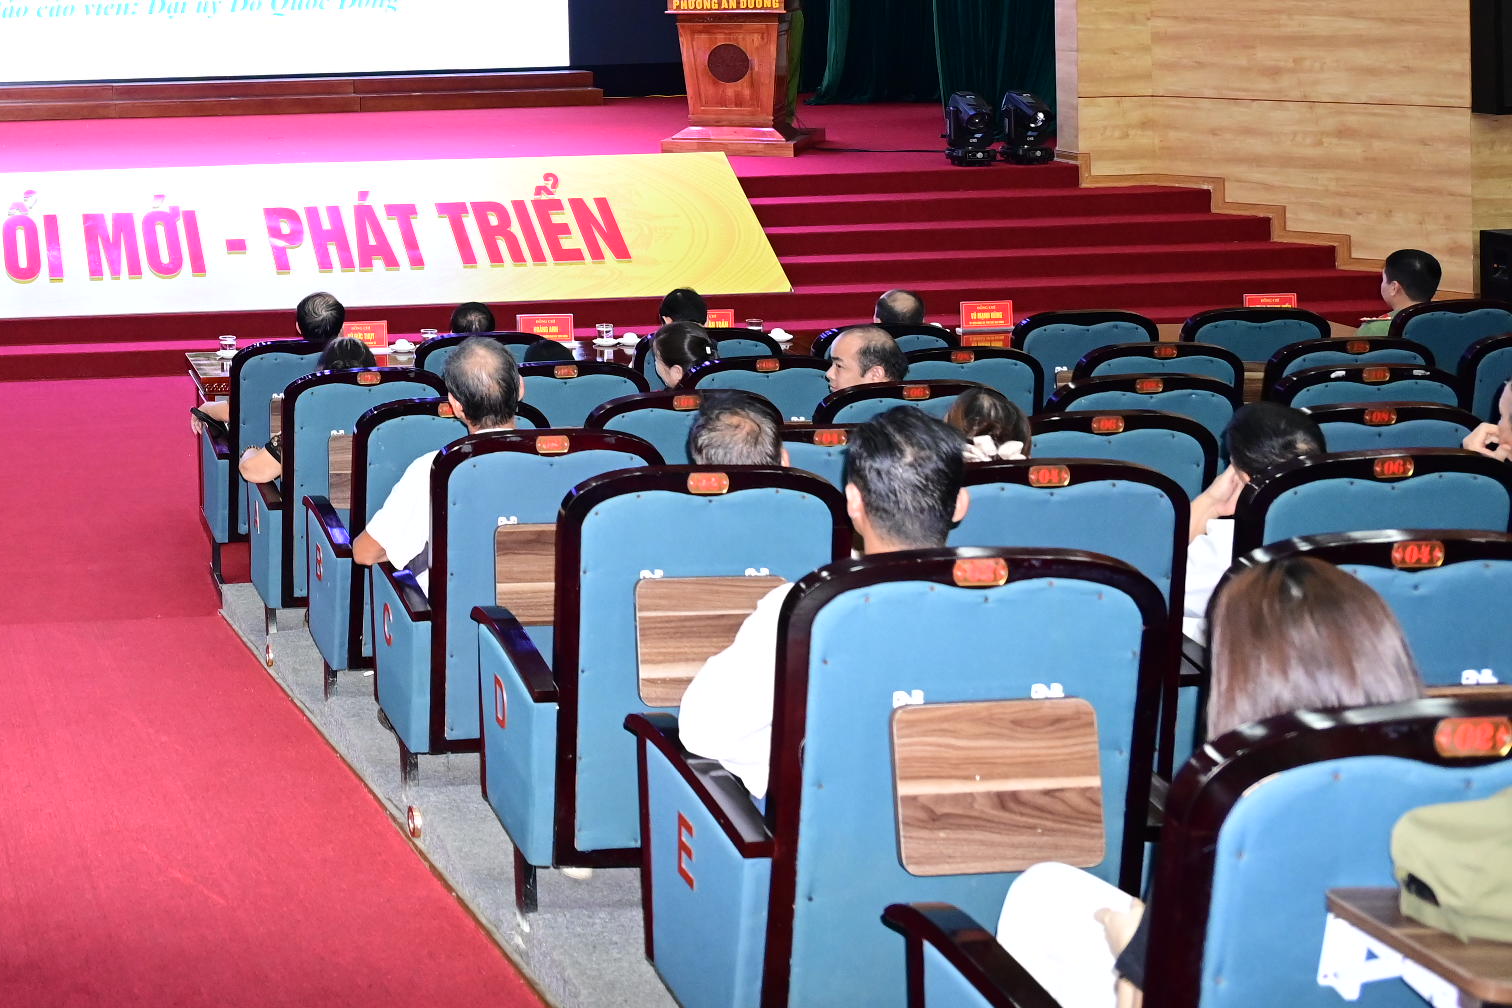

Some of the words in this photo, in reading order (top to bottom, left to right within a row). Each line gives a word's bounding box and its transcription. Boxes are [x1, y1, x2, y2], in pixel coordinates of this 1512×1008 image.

[721, 0, 737, 9] AN
[83, 193, 207, 281] MỚI
[263, 190, 426, 276] PHÁT
[435, 172, 633, 269] TRIỂN
[383, 603, 393, 646] C
[494, 672, 507, 729] D
[677, 810, 696, 891] E
